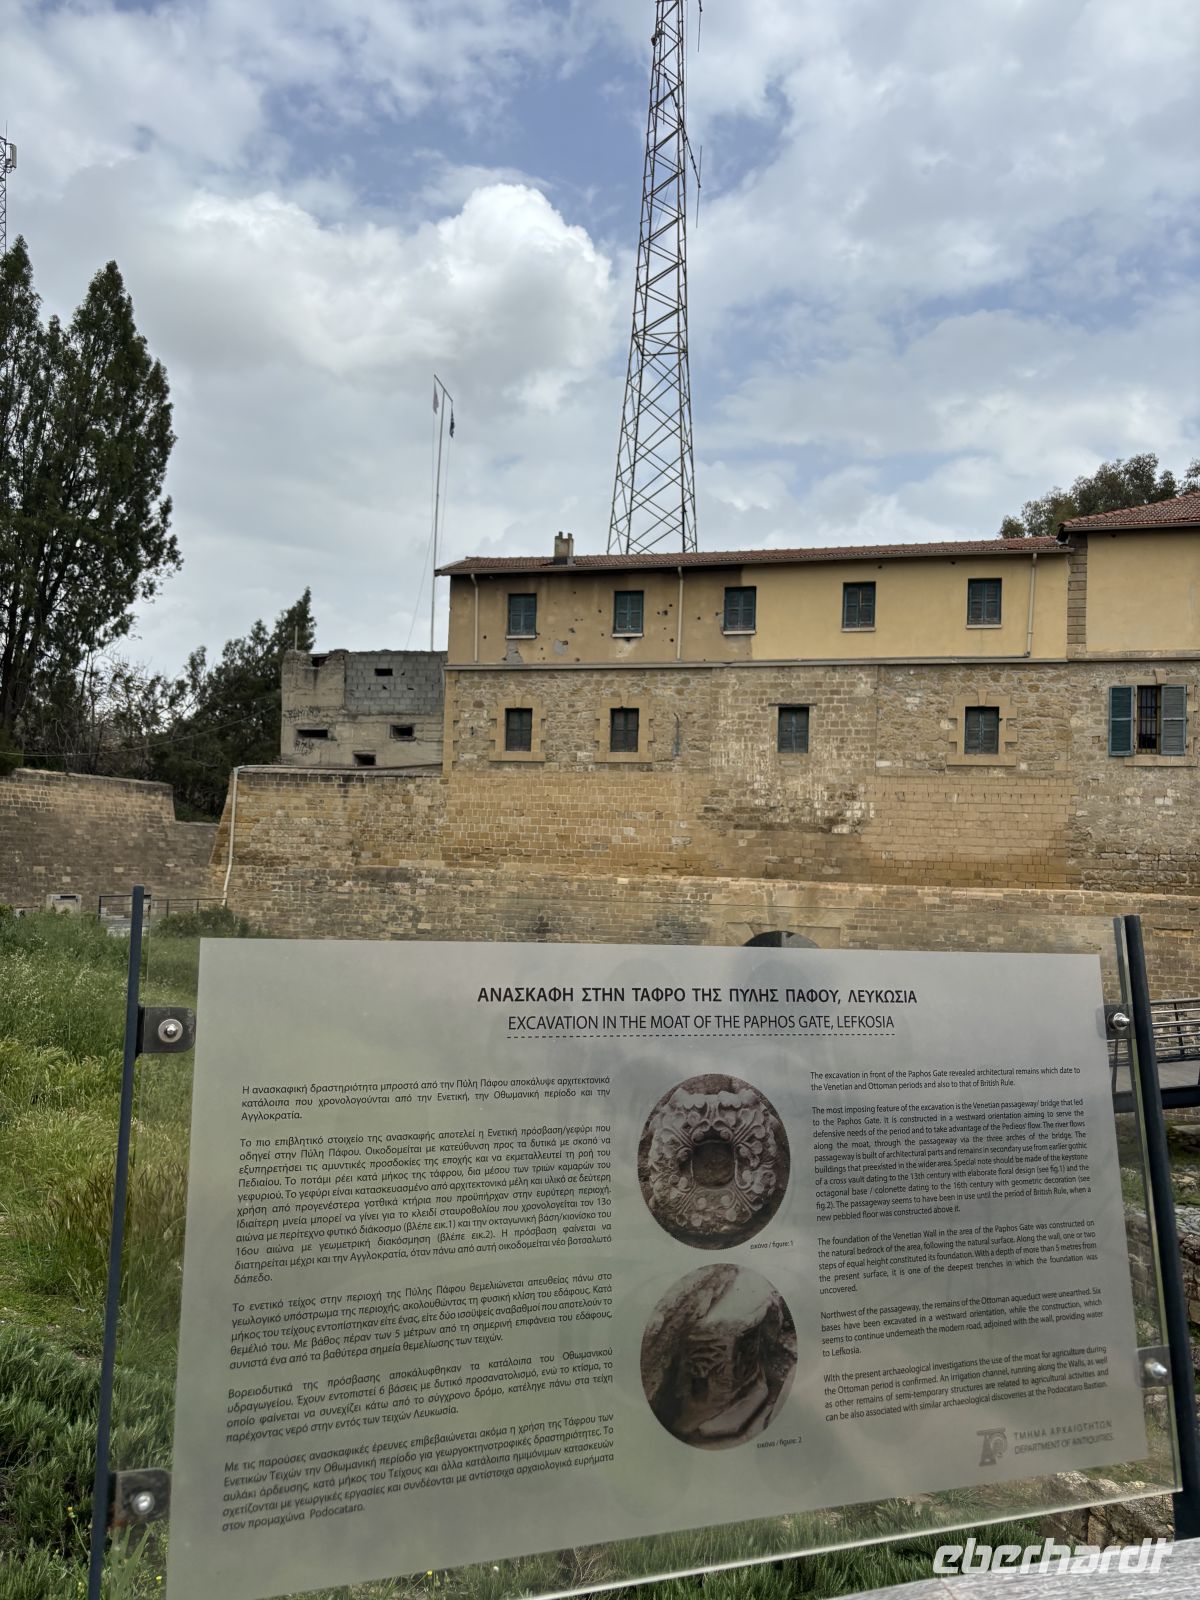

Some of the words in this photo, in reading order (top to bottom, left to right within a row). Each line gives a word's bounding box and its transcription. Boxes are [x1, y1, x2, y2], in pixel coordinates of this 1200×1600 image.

[477, 986, 573, 1002] ΑΝΑΣΚΑΦΗ
[581, 987, 624, 1001] ΣΤΗΝ
[631, 987, 685, 1002] ΤΑΦΡΟ
[691, 987, 722, 1002] ΤΗΣ
[729, 988, 778, 1002] ΠΥΛΗΣ
[785, 988, 840, 1004] ΠΑΦΟΥ,
[847, 989, 917, 1003] ΛΕΥΚΩΣΙΑ
[508, 1015, 598, 1030] EXCAVATION
[602, 1015, 616, 1029] IN
[619, 1015, 647, 1029] THE
[650, 1015, 690, 1028] MOAT
[693, 1015, 711, 1028] OF
[714, 1015, 740, 1028] THE
[743, 1015, 795, 1028] PAPHOS
[798, 1015, 833, 1030] GATE,
[836, 1015, 894, 1028] LEFKOSIA
[810, 1071, 823, 1079] The
[824, 1071, 860, 1079] excavation
[869, 1070, 886, 1078] front
[887, 1070, 894, 1078] of
[895, 1070, 907, 1078] the
[907, 1069, 931, 1079] Paphos
[932, 1069, 948, 1077] Gate
[948, 1068, 975, 1076] revealed
[976, 1067, 1014, 1076] architectural
[1015, 1067, 1039, 1075] remains
[1040, 1066, 1058, 1074] which
[1059, 1066, 1073, 1074] date
[242, 1085, 249, 1094] Η
[380, 1080, 418, 1092] μπροστά
[420, 1080, 438, 1089] από
[439, 1081, 454, 1090] την
[456, 1078, 478, 1089] Πύλη
[480, 1078, 508, 1088] Πάφου
[810, 1083, 822, 1091] the
[822, 1082, 853, 1091] Venetian
[853, 1081, 867, 1090] and
[867, 1081, 897, 1090] Ottoman
[898, 1081, 922, 1090] periods
[923, 1080, 936, 1088] and
[937, 1079, 950, 1088] also
[958, 1079, 971, 1087] that
[972, 1079, 979, 1087] of
[979, 1078, 999, 1087] British
[1000, 1078, 1015, 1086] Rule.
[295, 1098, 313, 1106] που
[394, 1093, 412, 1102] από
[416, 1094, 432, 1103] την
[437, 1091, 469, 1102] Ενετική,
[474, 1093, 489, 1101] την
[544, 1088, 576, 1099] περίοδο
[239, 1138, 252, 1147] Το
[255, 1139, 270, 1147] πιο
[327, 1134, 364, 1145] στοιχείο
[367, 1135, 382, 1144] της
[438, 1128, 475, 1139] αποτελεί
[478, 1130, 484, 1139] η
[487, 1127, 517, 1137] Ενετική
[236, 1204, 267, 1217] χρήση
[271, 1202, 291, 1213] από
[363, 1196, 398, 1209] γοτθικά
[402, 1195, 431, 1207] κτήρια
[435, 1195, 452, 1203] που
[512, 1191, 532, 1200] στην
[536, 1187, 574, 1198] ευρύτερη
[578, 1184, 611, 1196] περιοχή.
[816, 1214, 831, 1222] new
[832, 1210, 861, 1222] pebbled
[862, 1209, 879, 1218] floor
[893, 1206, 932, 1216] constructed
[933, 1204, 953, 1214] above
[233, 1271, 272, 1286] δάπεδο.
[232, 1302, 245, 1312] Το
[249, 1298, 283, 1311] ενετικό
[287, 1297, 316, 1309] τείχος
[319, 1295, 342, 1305] στην
[346, 1290, 382, 1303] περιοχή
[385, 1290, 401, 1300] της
[405, 1286, 432, 1297] Πύλης
[436, 1284, 466, 1295] Πάφου
[571, 1273, 594, 1283] πάνω
[597, 1273, 612, 1281] στο
[819, 1283, 858, 1296] uncovered.
[820, 1309, 857, 1319] Northwest
[857, 1306, 865, 1316] of
[866, 1306, 878, 1315] the
[879, 1304, 921, 1316] passageway,
[921, 1301, 933, 1310] the
[934, 1299, 960, 1309] remains
[960, 1297, 968, 1306] of
[968, 1297, 980, 1305] the
[980, 1296, 1010, 1304] Ottoman
[1010, 1292, 1041, 1303] aqueduct
[1058, 1287, 1091, 1298] unearthed.
[822, 1349, 830, 1357] to
[831, 1345, 862, 1357] Lefkosia.
[302, 1380, 318, 1391] της
[539, 1355, 554, 1363] του
[285, 1423, 308, 1436] νερό
[310, 1421, 333, 1432] στην
[335, 1416, 361, 1429] εντός
[362, 1415, 380, 1425] των
[381, 1410, 412, 1423] τειχών
[1014, 1428, 1047, 1441] ΤΜΗΜΑ
[1014, 1440, 1060, 1455] DEPARTMENT
[1061, 1440, 1070, 1449] OF
[221, 1520, 246, 1532] στον
